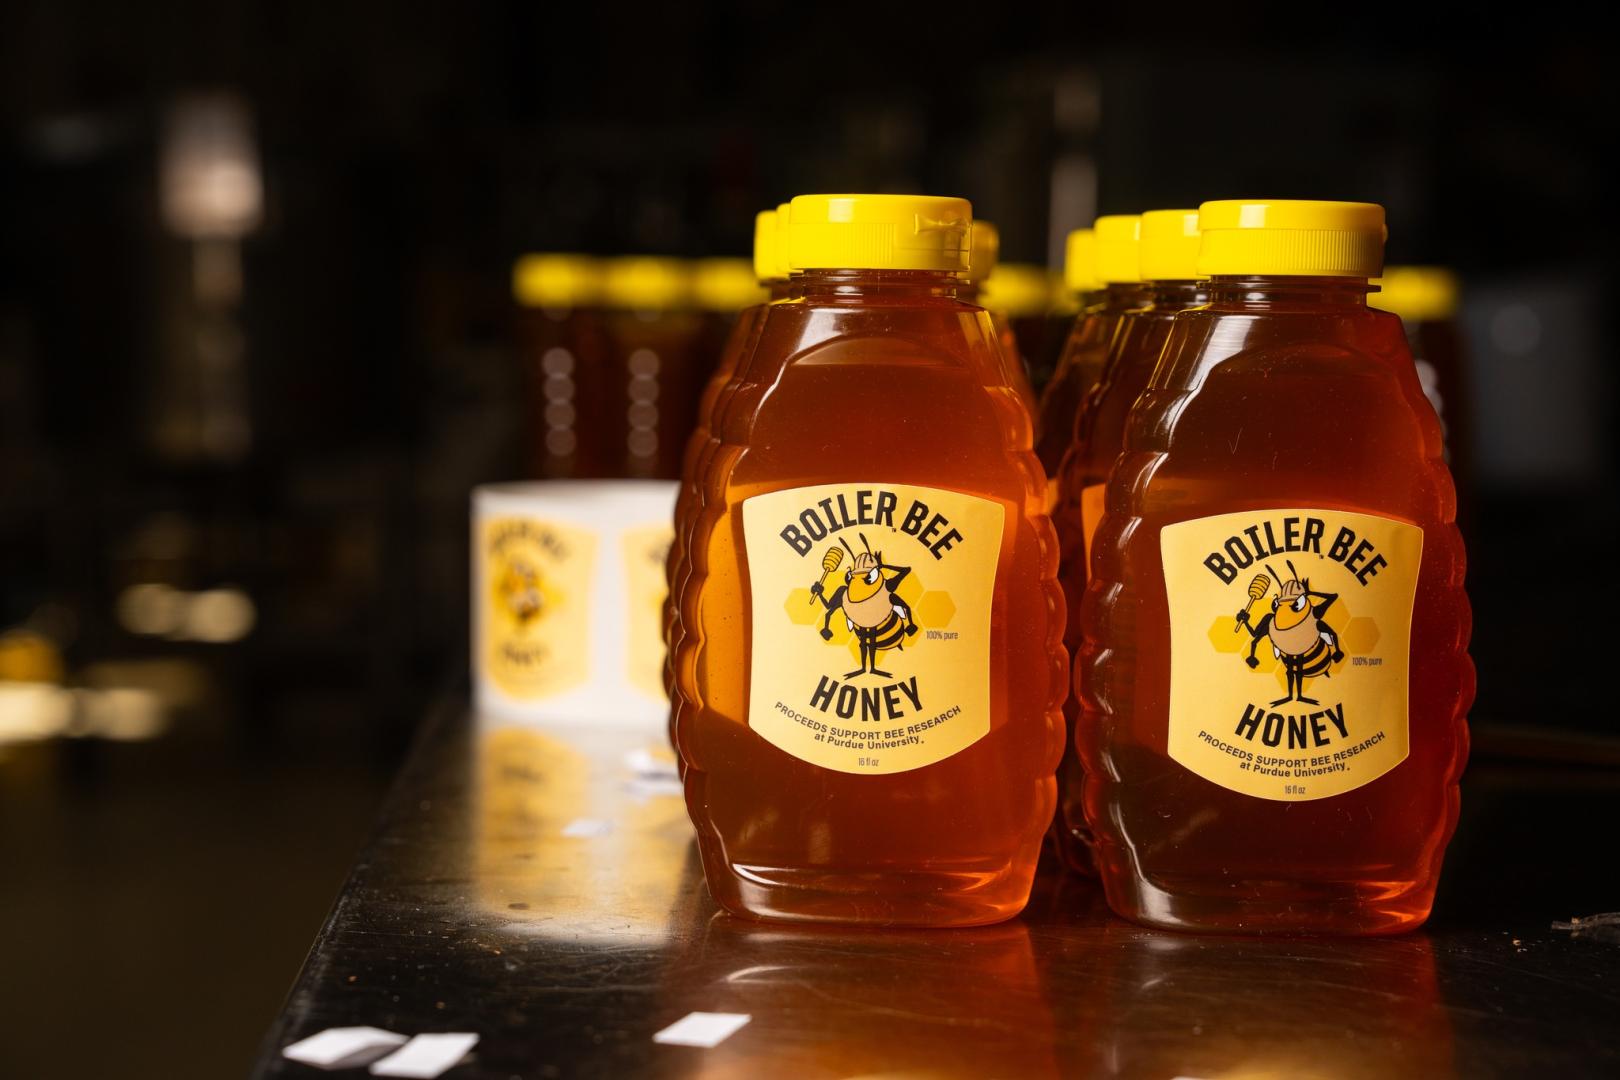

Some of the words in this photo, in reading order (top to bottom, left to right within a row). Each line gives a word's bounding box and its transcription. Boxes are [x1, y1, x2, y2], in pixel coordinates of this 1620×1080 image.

[780, 490, 897, 558] BOILER
[901, 500, 963, 560] BEE
[1203, 517, 1325, 585] BOILER
[1328, 526, 1387, 587] BEE
[926, 630, 942, 640] 100%
[944, 632, 958, 640] pure
[1352, 657, 1367, 666] 100%
[1369, 658, 1382, 666] pure
[809, 675, 923, 722] HONEY
[774, 702, 828, 733] PROCEEDS
[830, 728, 881, 740] SUPPORT
[884, 728, 905, 738] BEE
[908, 706, 960, 734] RESEARCH
[1235, 703, 1349, 750] HONEY
[815, 732, 825, 741] at
[827, 736, 864, 749] Purdue
[1198, 731, 1253, 761] PROCEEDS
[1256, 756, 1307, 768] SUPPORT
[1311, 755, 1331, 766] BEE
[1334, 732, 1385, 761] RESEARCH
[1240, 761, 1251, 769] at
[1253, 764, 1290, 777] Purdue
